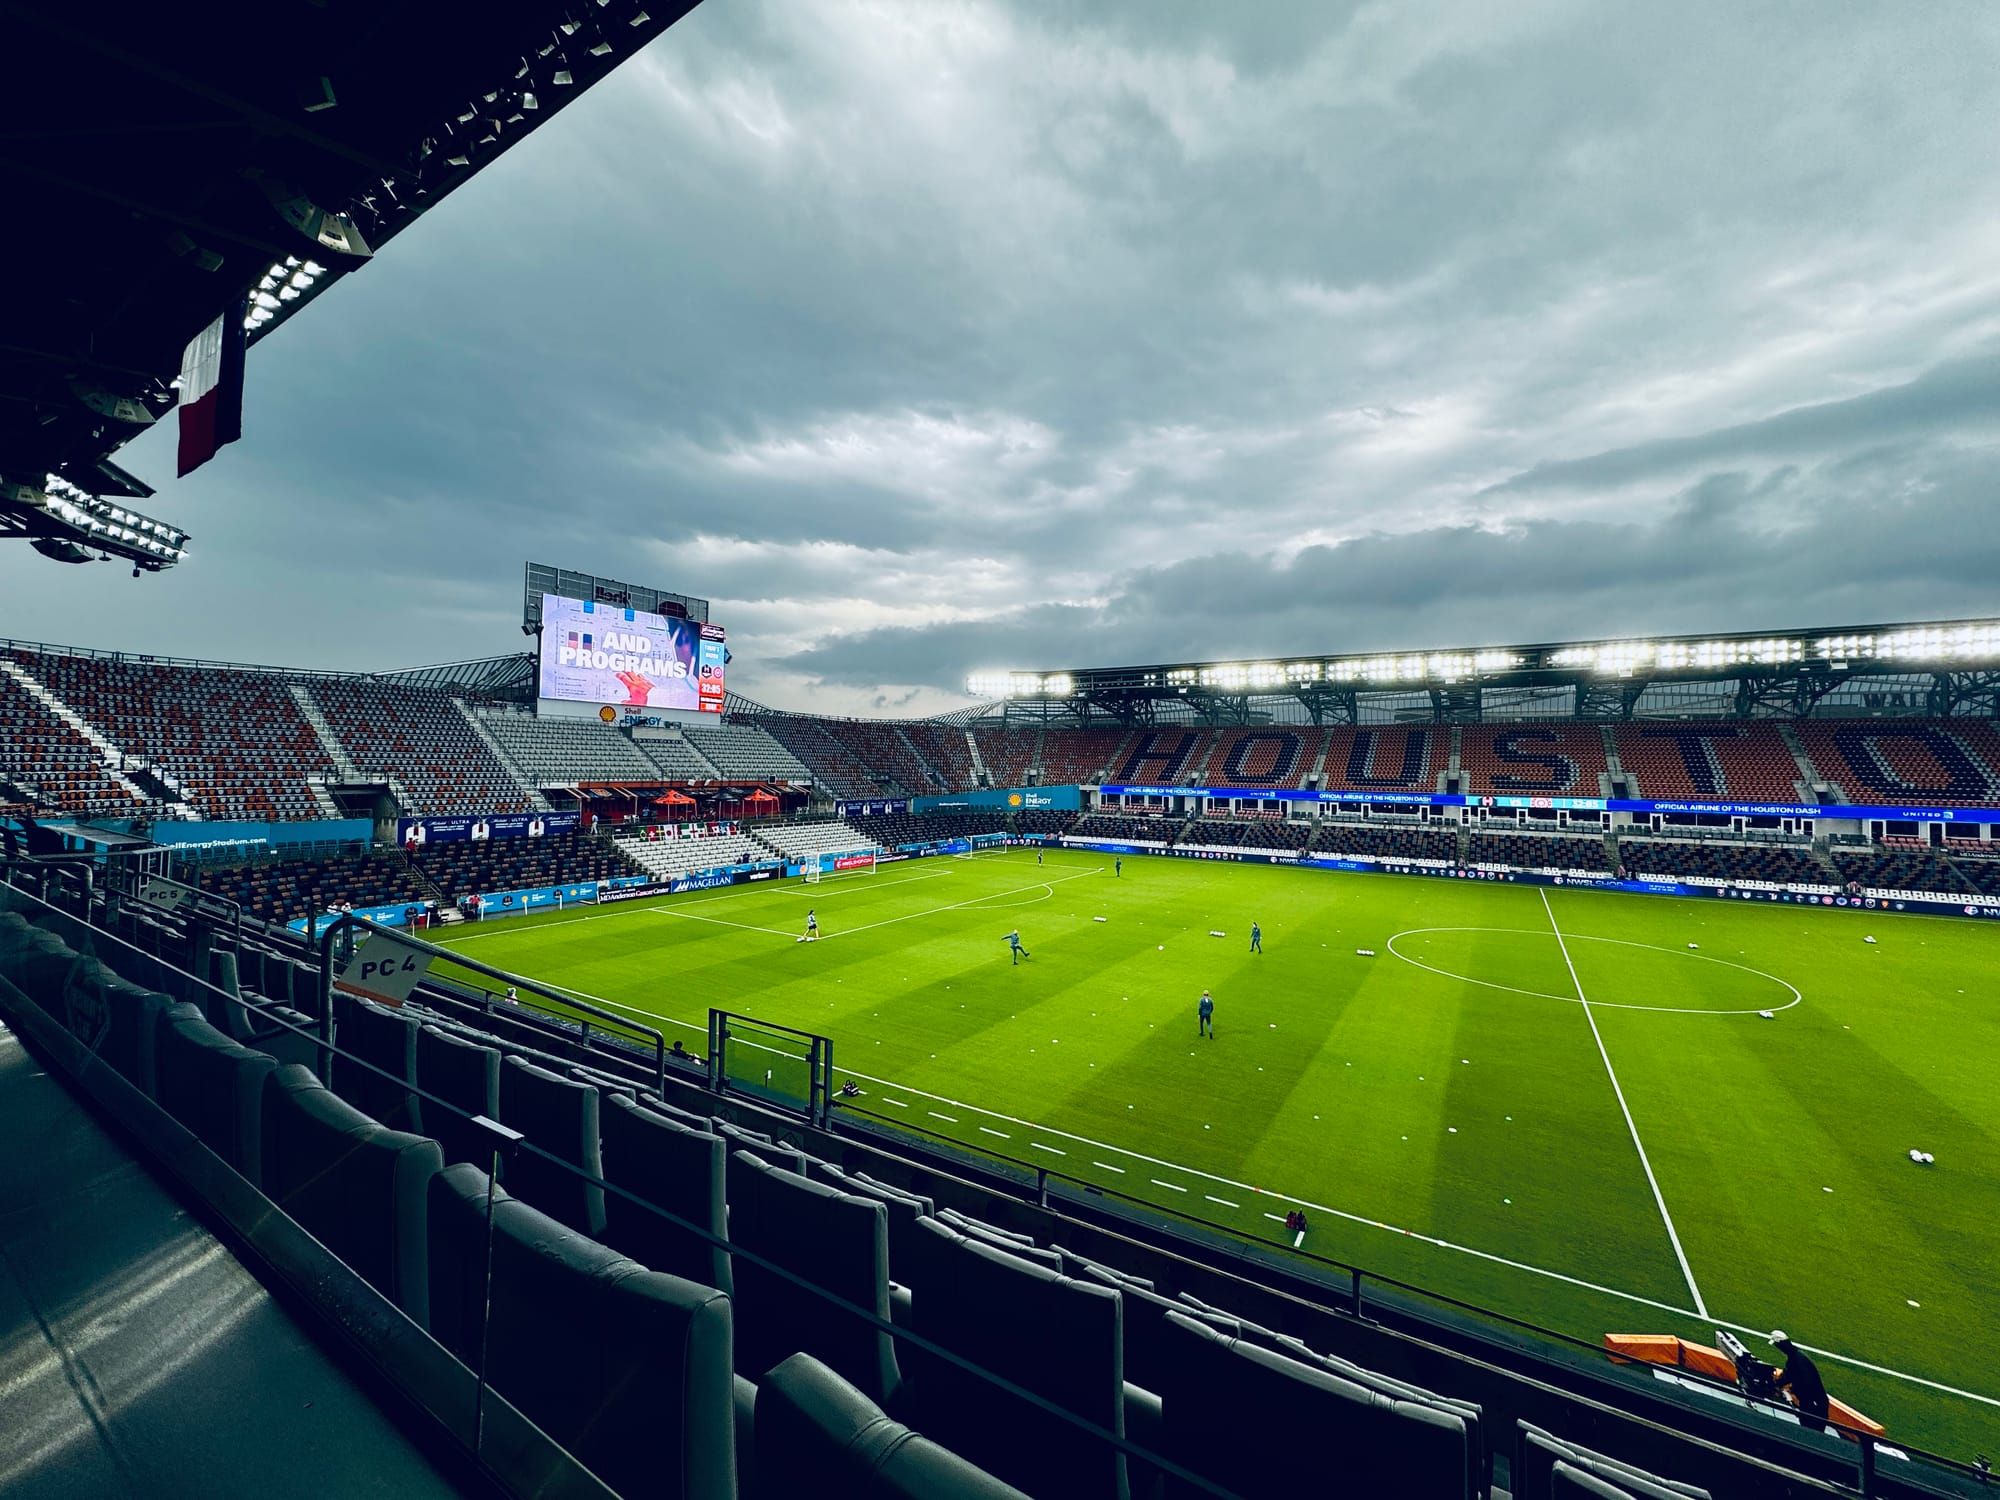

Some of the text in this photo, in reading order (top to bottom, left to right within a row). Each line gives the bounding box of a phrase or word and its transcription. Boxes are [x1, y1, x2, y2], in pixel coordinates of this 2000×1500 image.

[602, 631, 652, 654] AND
[559, 646, 687, 679] PROGRAMS
[624, 707, 642, 715] Shell
[624, 715, 662, 726] ENERGY
[690, 876, 731, 890] MAGELLAN
[149, 890, 178, 900] PC 5
[611, 892, 635, 900] Anderson
[360, 954, 416, 980] PC 4
